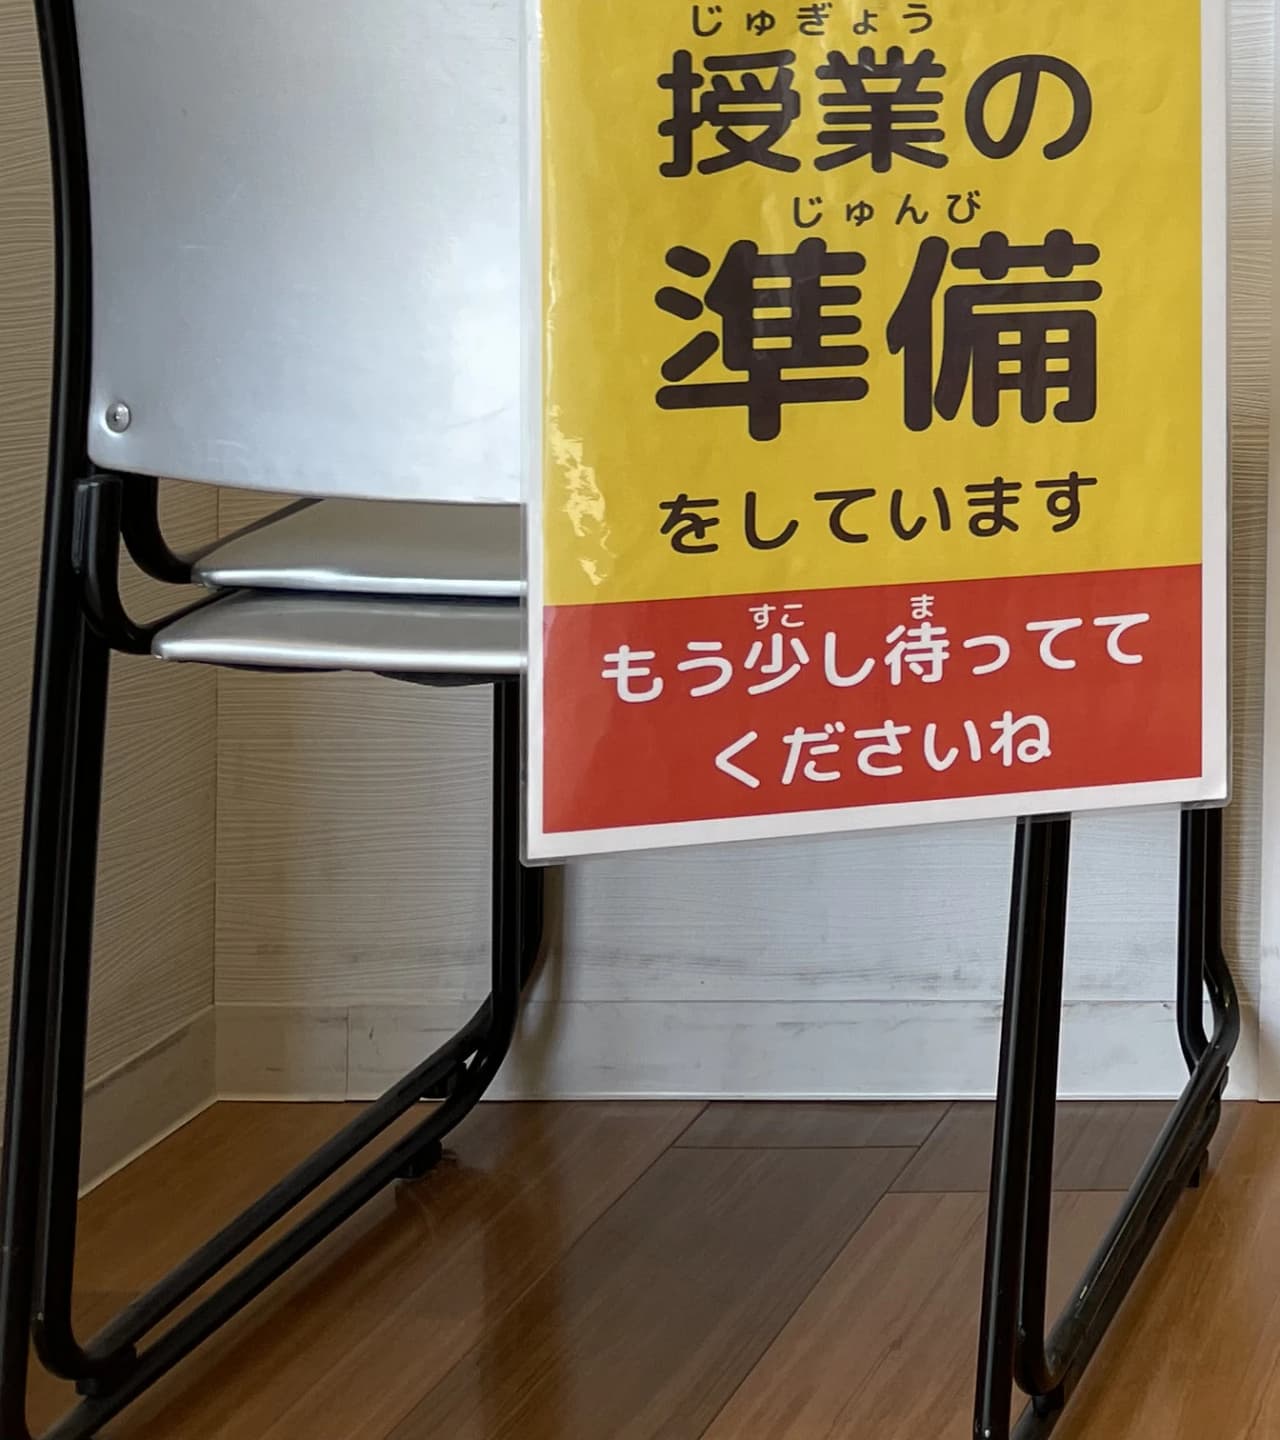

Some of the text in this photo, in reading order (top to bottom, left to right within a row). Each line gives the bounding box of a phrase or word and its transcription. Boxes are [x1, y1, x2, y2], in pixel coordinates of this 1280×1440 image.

[691, 1, 935, 37] じゅぎょう
[656, 43, 1094, 178] 授業の
[791, 190, 982, 229] じゅんび
[654, 228, 1104, 442] 準備
[658, 470, 1099, 554] をしています
[749, 602, 805, 631] すこ
[910, 593, 935, 619] ま
[602, 610, 1150, 704] もう少し待ってて
[712, 709, 1052, 789] くださいね
